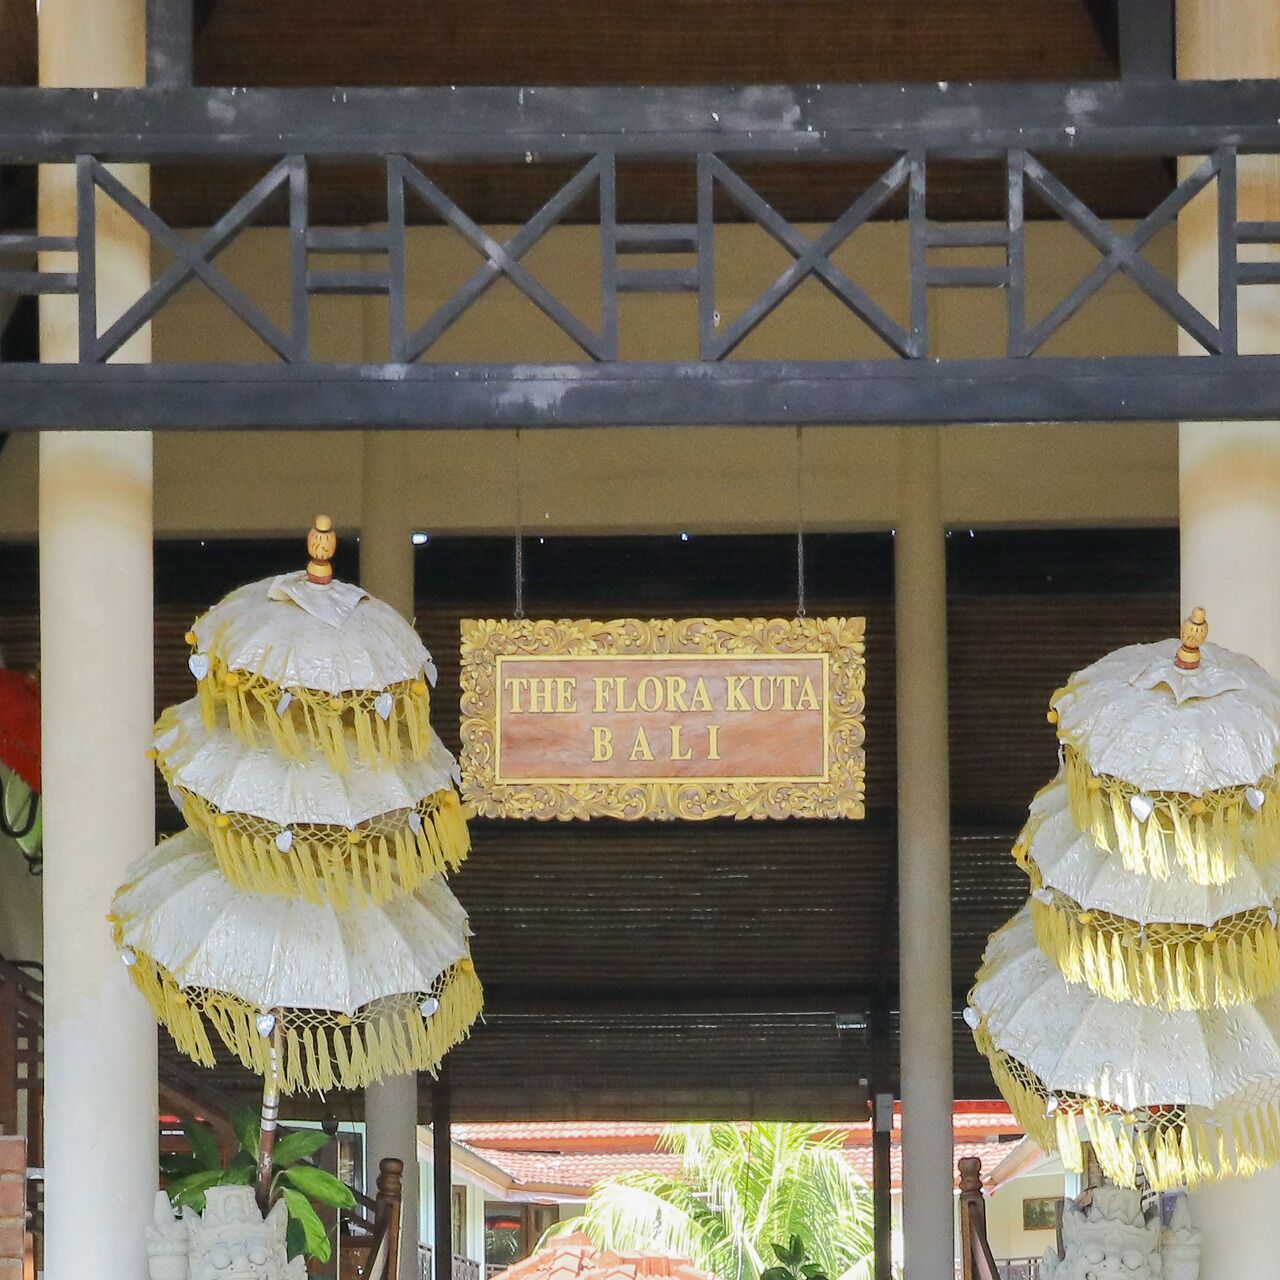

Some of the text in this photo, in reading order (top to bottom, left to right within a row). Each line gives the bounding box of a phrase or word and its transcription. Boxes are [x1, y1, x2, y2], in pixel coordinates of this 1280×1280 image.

[504, 674, 821, 713] THE FLORA KUTA
[591, 725, 721, 763] BALI
